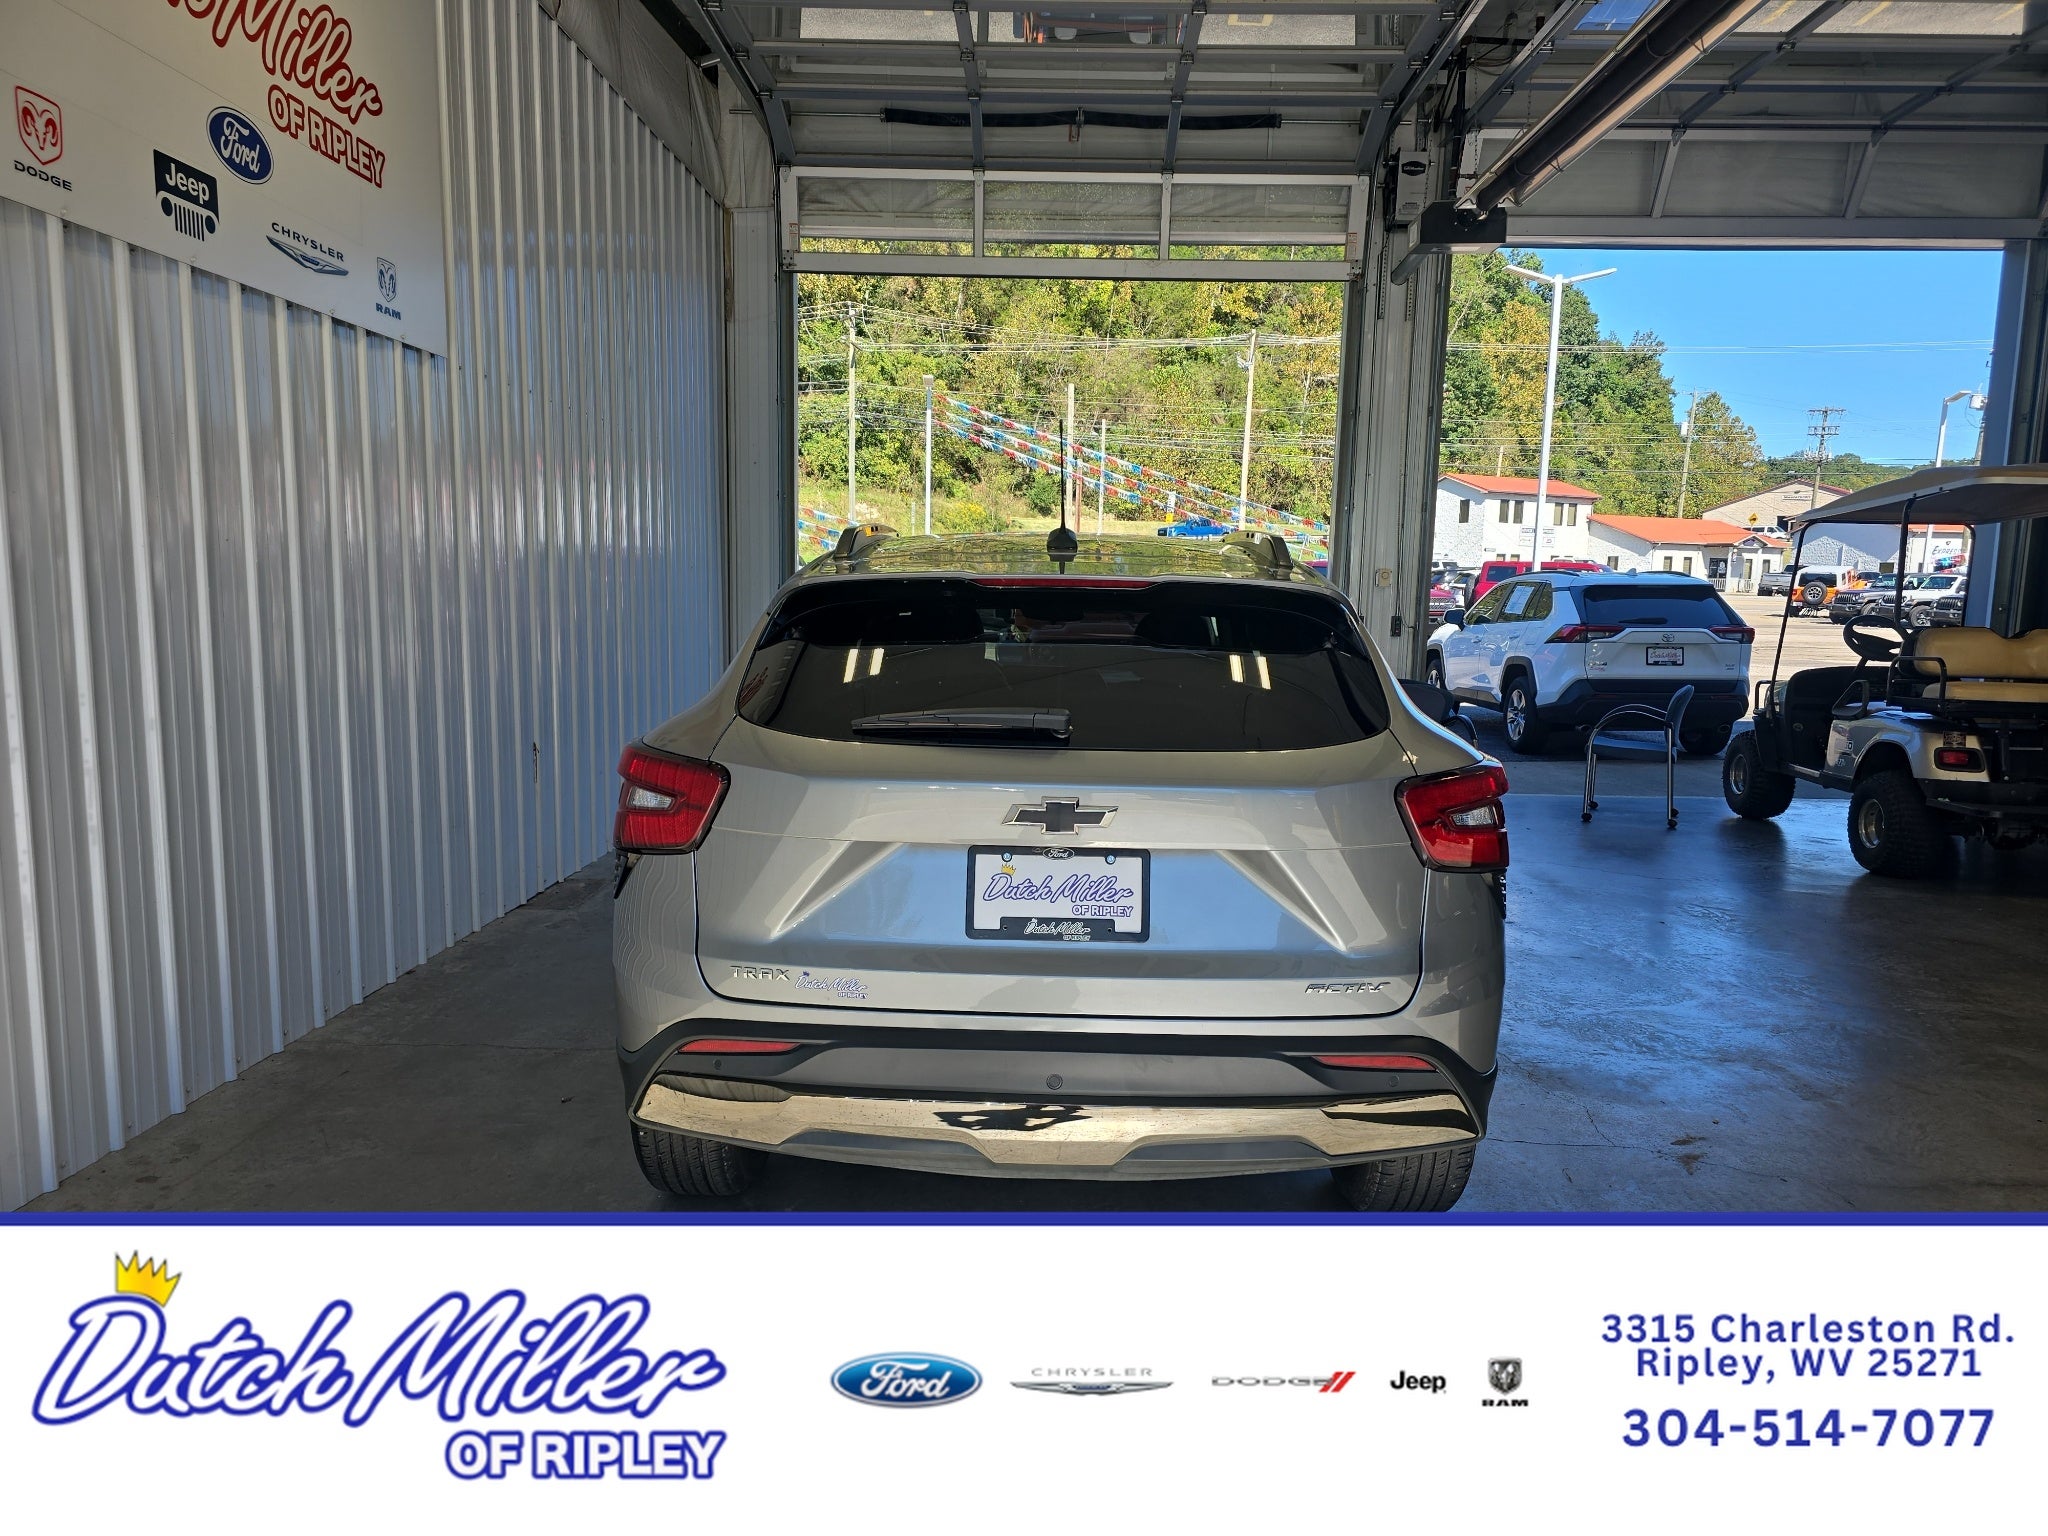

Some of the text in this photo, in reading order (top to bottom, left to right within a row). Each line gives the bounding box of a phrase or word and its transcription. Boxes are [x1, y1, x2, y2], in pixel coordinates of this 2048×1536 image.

[268, 84, 386, 188] OF RIPLEY
[221, 117, 260, 174] Ford
[13, 160, 73, 191] DODGE
[165, 163, 209, 204] Jeep
[271, 222, 345, 262] CHRYSLER
[375, 302, 402, 320] RAM
[1048, 848, 1069, 858] Ford
[983, 873, 1134, 903] Dutch Miller
[1072, 905, 1133, 917] OF RIPLEY
[1024, 920, 1091, 935] Dutch Miller
[729, 965, 790, 981] TRAX
[795, 975, 868, 992] Dutch Miller
[1305, 981, 1391, 994] ACTIV
